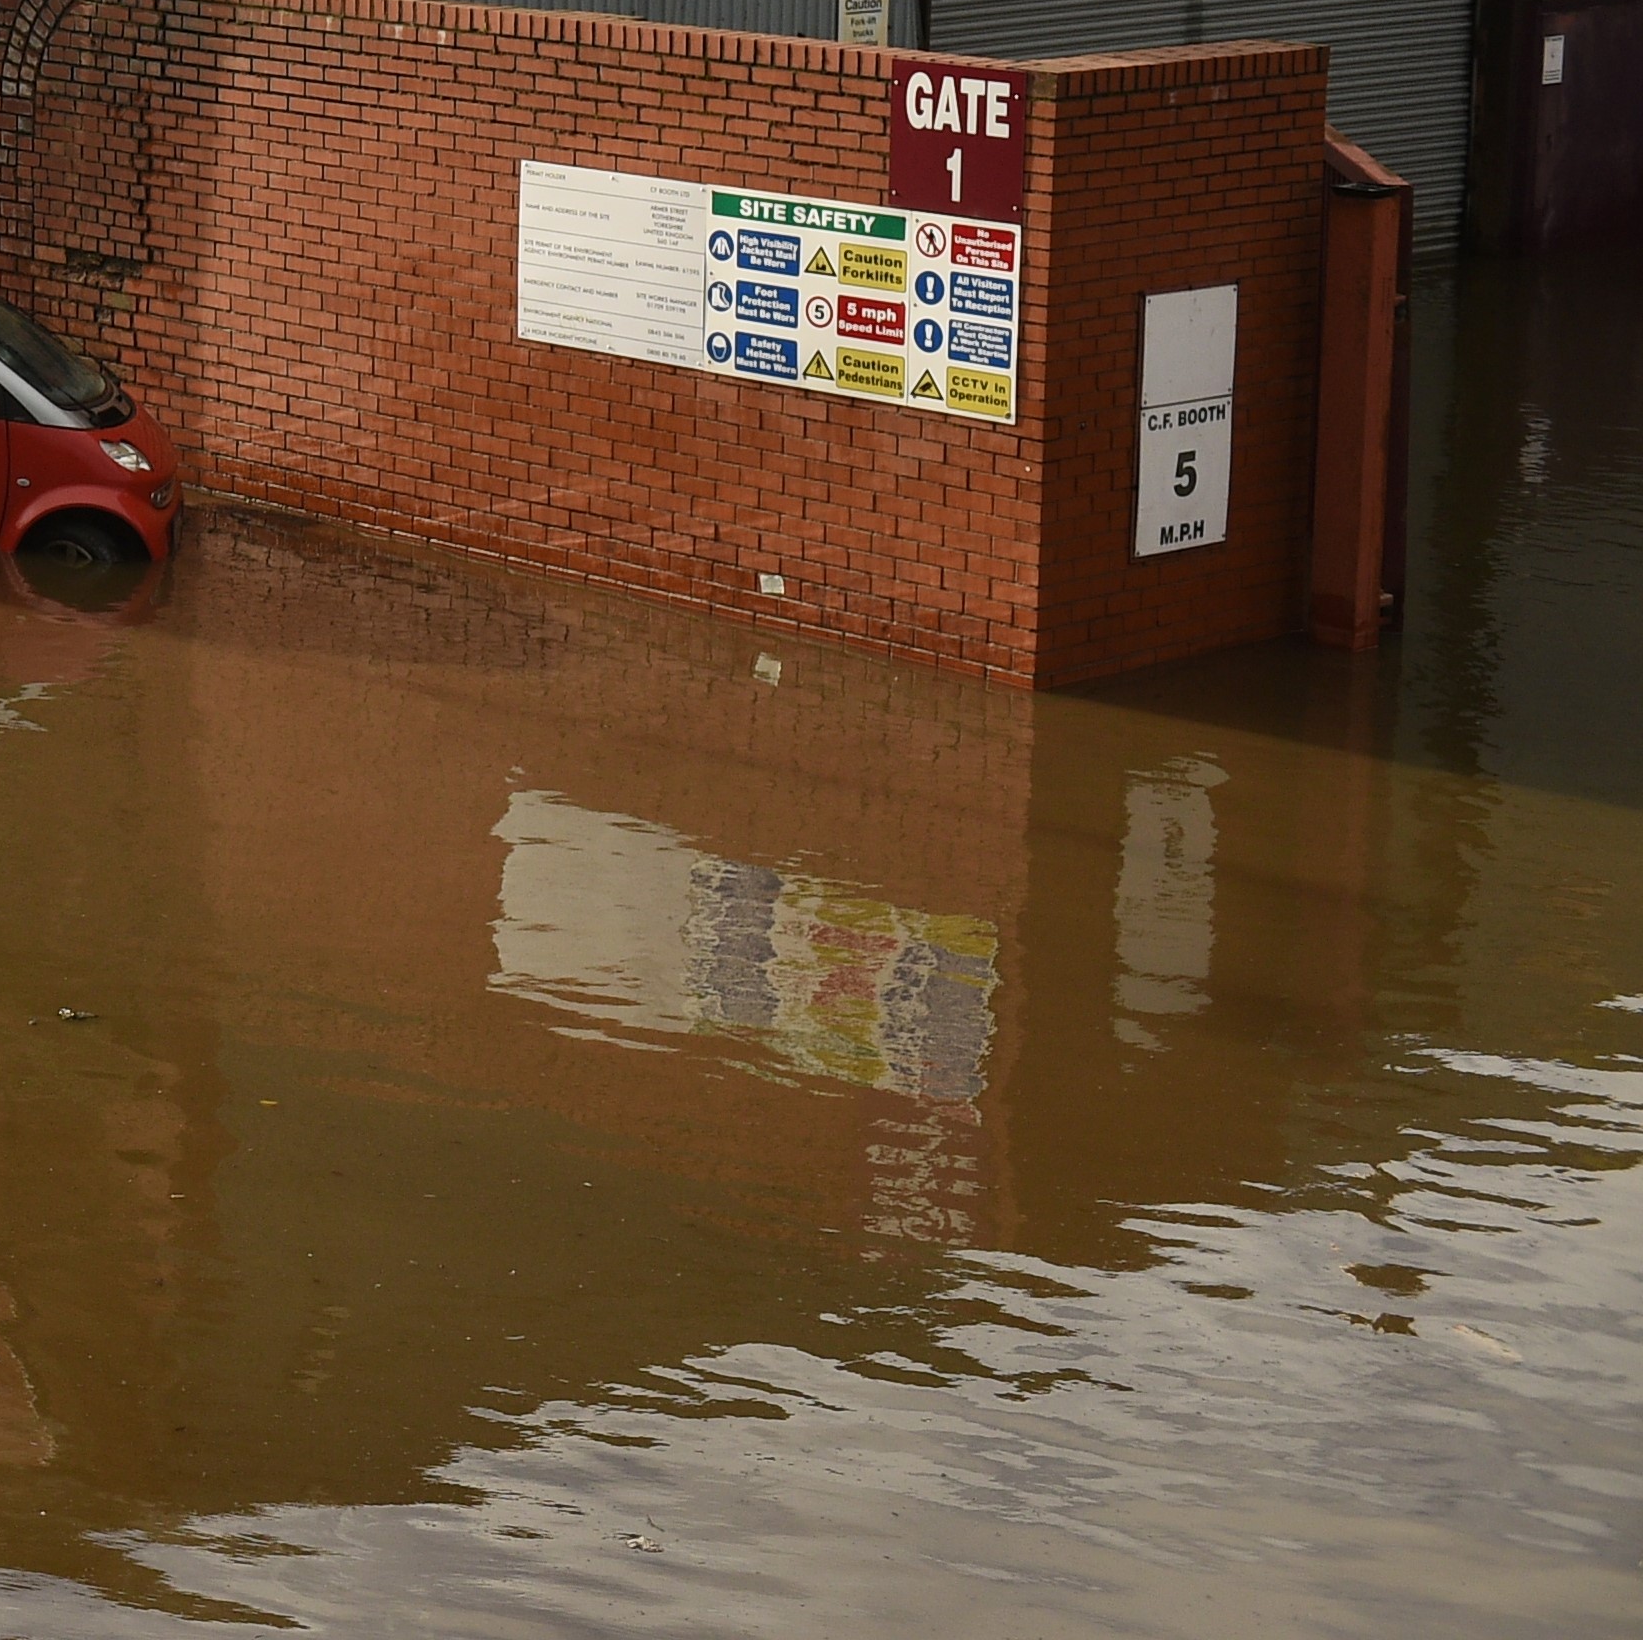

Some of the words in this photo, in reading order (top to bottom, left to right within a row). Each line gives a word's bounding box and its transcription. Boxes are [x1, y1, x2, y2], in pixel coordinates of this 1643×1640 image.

[905, 71, 1011, 139] GATE
[946, 148, 962, 203] 1
[555, 207, 577, 215] ADDRESS
[739, 198, 787, 222] SITE
[793, 206, 877, 234] SAFETY
[977, 229, 989, 238] No
[739, 235, 759, 248] High
[761, 236, 799, 252] Visibility
[955, 235, 1013, 251] Unauthorised
[740, 245, 774, 258] Jackets
[775, 250, 797, 262] Must
[843, 249, 903, 269] Caution
[965, 246, 1001, 259] Persons
[750, 256, 762, 266] Be
[763, 258, 787, 270] Worn
[956, 254, 969, 263] On
[971, 256, 989, 267] This
[991, 259, 1009, 270] Site
[843, 266, 903, 285] Forklifts
[957, 276, 969, 286] All
[971, 278, 1007, 292] Visitors
[755, 286, 778, 298] Foot
[953, 287, 976, 298] Must
[978, 291, 1009, 304] Report
[741, 295, 791, 311] Protection
[952, 298, 963, 308] To
[965, 301, 1011, 315] Reception
[737, 306, 758, 317] Must
[759, 310, 771, 319] Be
[773, 312, 795, 323] Worn
[815, 305, 825, 320] 5
[847, 302, 858, 316] 5
[861, 306, 897, 323] mph
[839, 320, 873, 334] Speed
[875, 325, 904, 339] Limit
[963, 323, 1009, 336] Contractors
[750, 338, 782, 352] Safety
[951, 344, 976, 354] Before
[978, 349, 1009, 361] Starting
[960, 338, 979, 347] Work
[981, 341, 1007, 352] Permit
[745, 348, 787, 362] Helmets
[969, 354, 989, 364] Work
[736, 357, 758, 369] Must
[759, 361, 772, 371] Be
[773, 362, 797, 374] Worn
[842, 354, 899, 374] Caution
[838, 369, 903, 390] Pedestrians
[952, 376, 989, 390] CCTV
[995, 383, 1006, 394] In
[949, 388, 1008, 407] Operation
[1147, 413, 1173, 431] C.F.
[1178, 404, 1226, 427] BOOTH
[1173, 450, 1197, 497] 5
[1159, 520, 1205, 545] M.P.H
